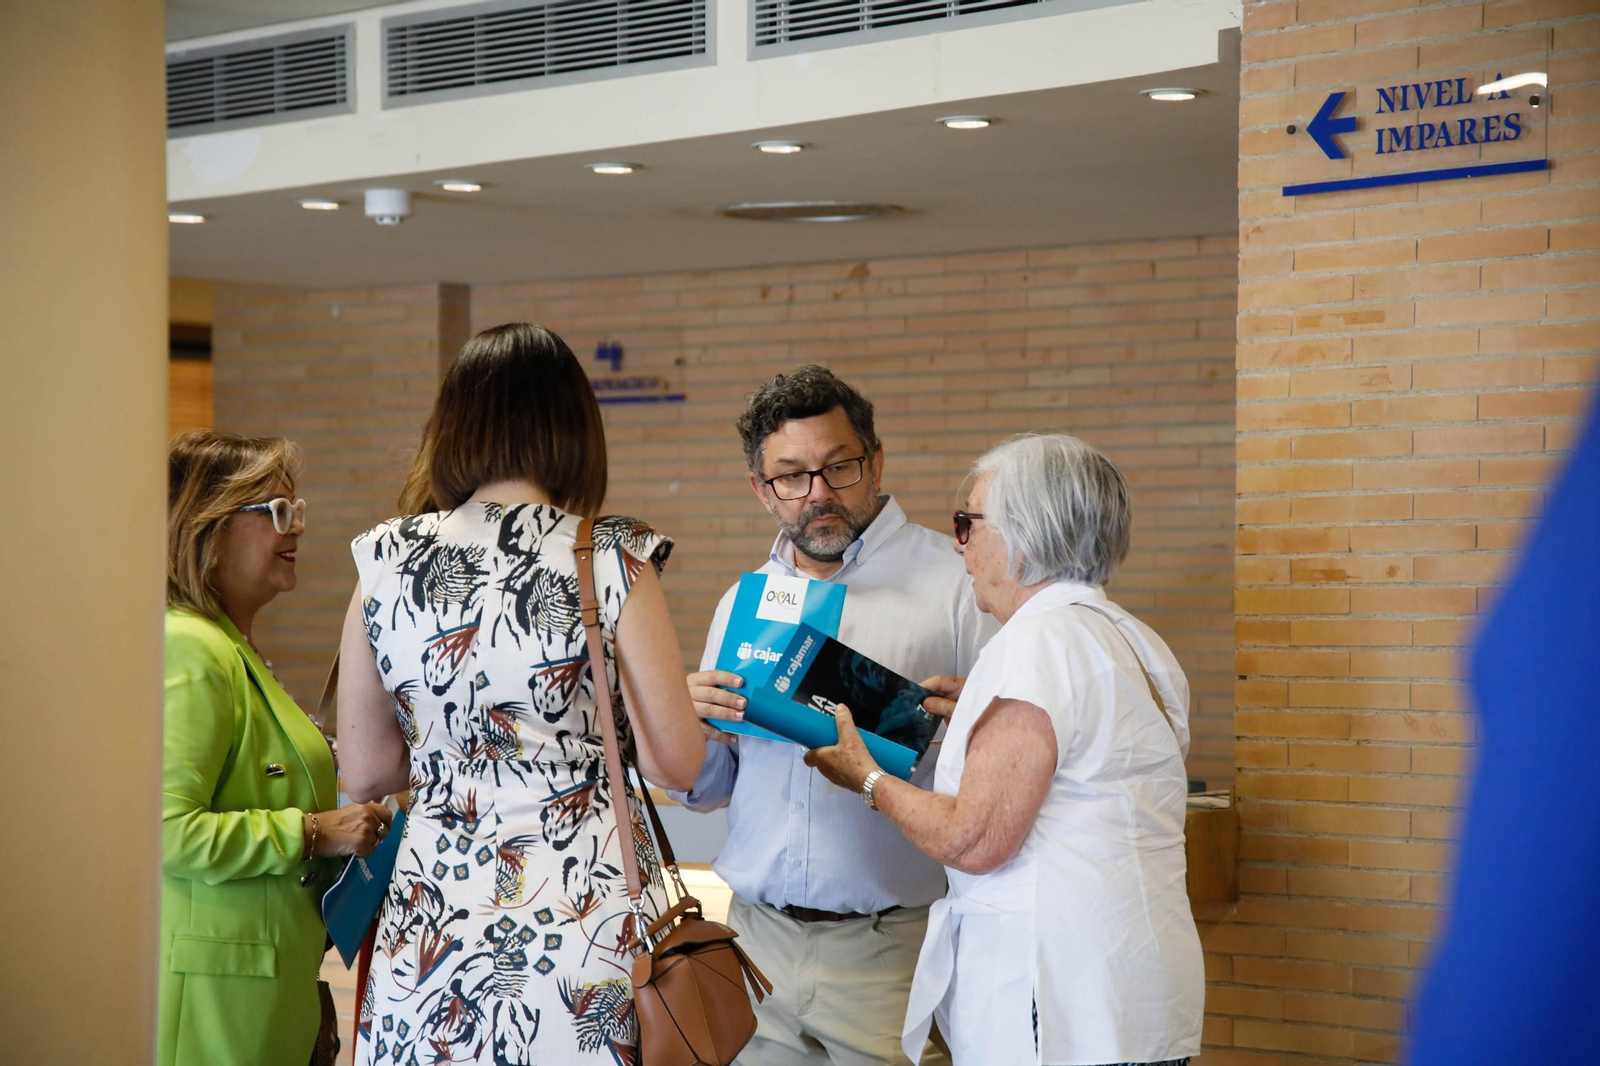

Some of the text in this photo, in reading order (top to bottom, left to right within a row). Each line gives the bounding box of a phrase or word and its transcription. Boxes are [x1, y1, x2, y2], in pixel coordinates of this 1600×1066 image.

[1376, 72, 1511, 114] NIVEL A
[1375, 112, 1522, 154] IMPARES
[787, 634, 814, 676] cajamar
